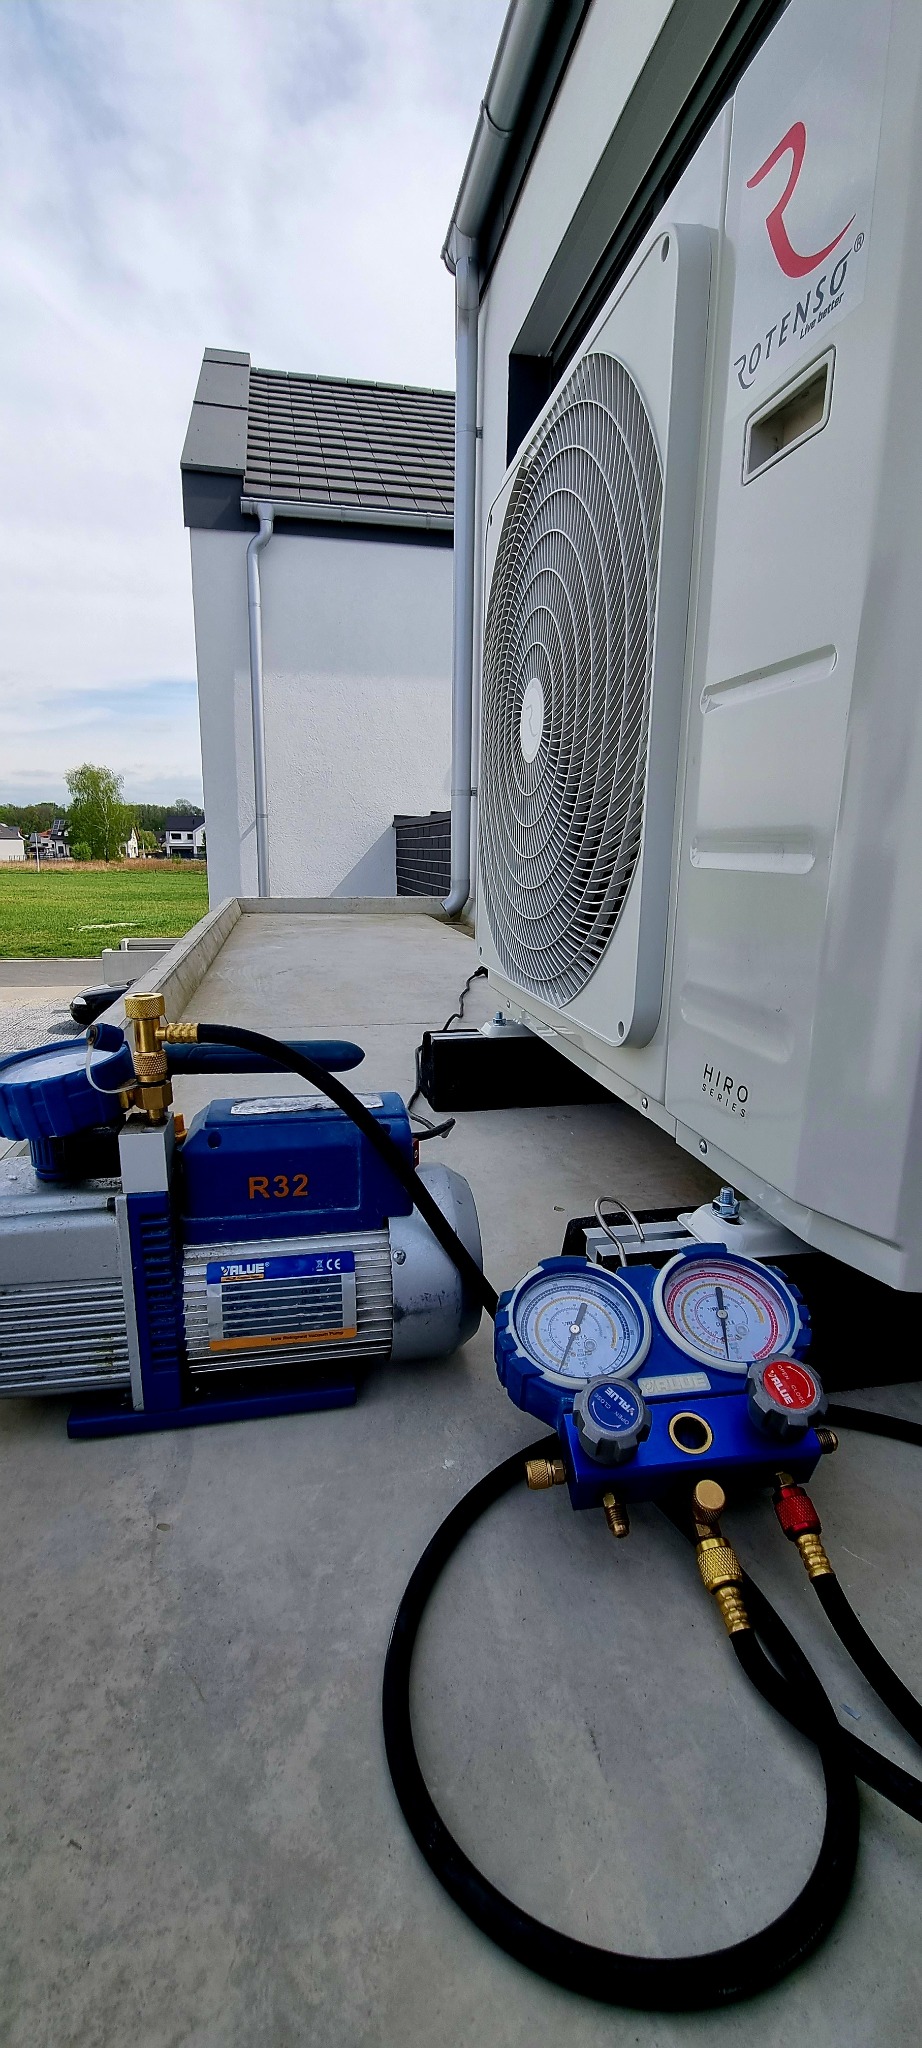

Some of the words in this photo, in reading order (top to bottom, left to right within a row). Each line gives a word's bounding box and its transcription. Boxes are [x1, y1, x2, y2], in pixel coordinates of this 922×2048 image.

[734, 248, 853, 389] ROTENSO
[800, 319, 817, 340] Live
[817, 291, 845, 323] better
[702, 1083, 746, 1117] SERIES
[703, 1063, 748, 1103] HIRO
[248, 1173, 309, 1199] R32
[221, 1263, 265, 1276] VALUE
[604, 1386, 635, 1416] VALUE
[768, 1370, 794, 1405] VALUE
